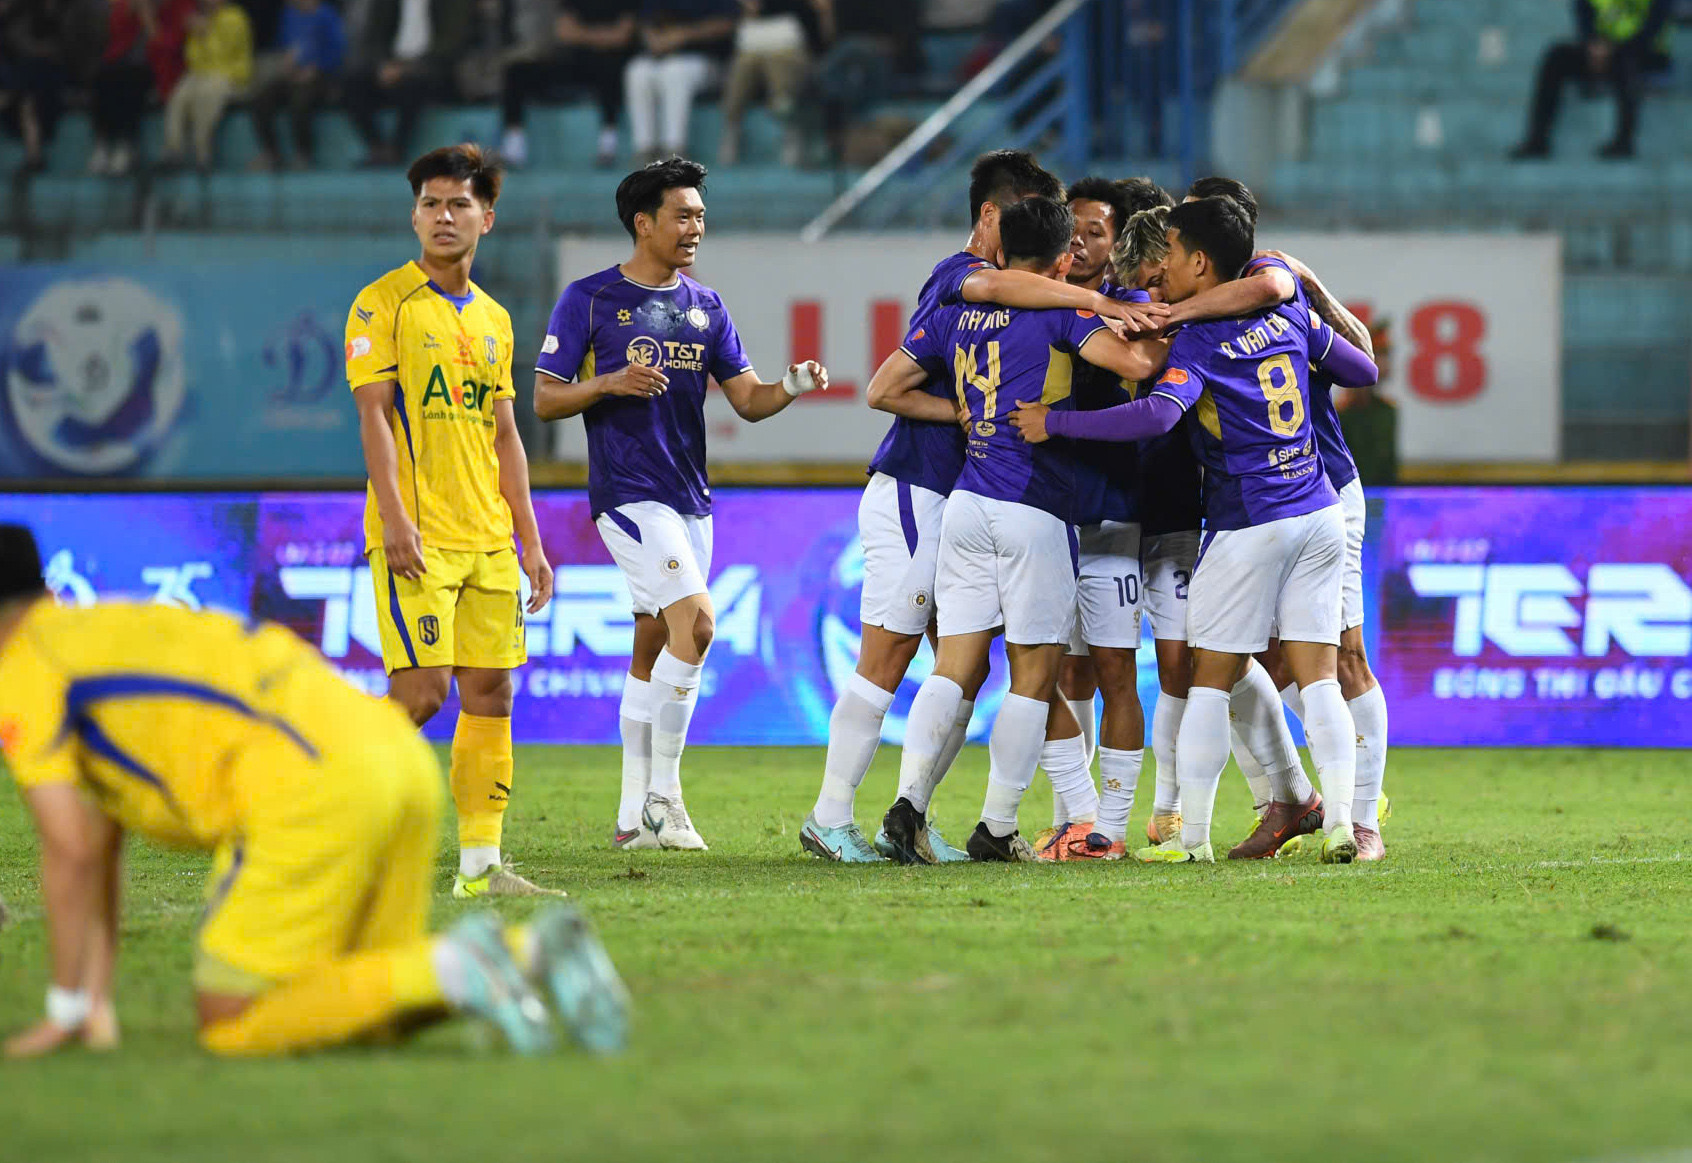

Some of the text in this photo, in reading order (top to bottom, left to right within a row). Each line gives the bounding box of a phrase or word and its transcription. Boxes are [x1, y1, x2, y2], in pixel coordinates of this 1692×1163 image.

[663, 341, 705, 361] T&T
[663, 358, 703, 372] HOMES
[1257, 354, 1305, 437] 8
[1113, 573, 1138, 607] 10
[1173, 570, 1189, 600] 2
